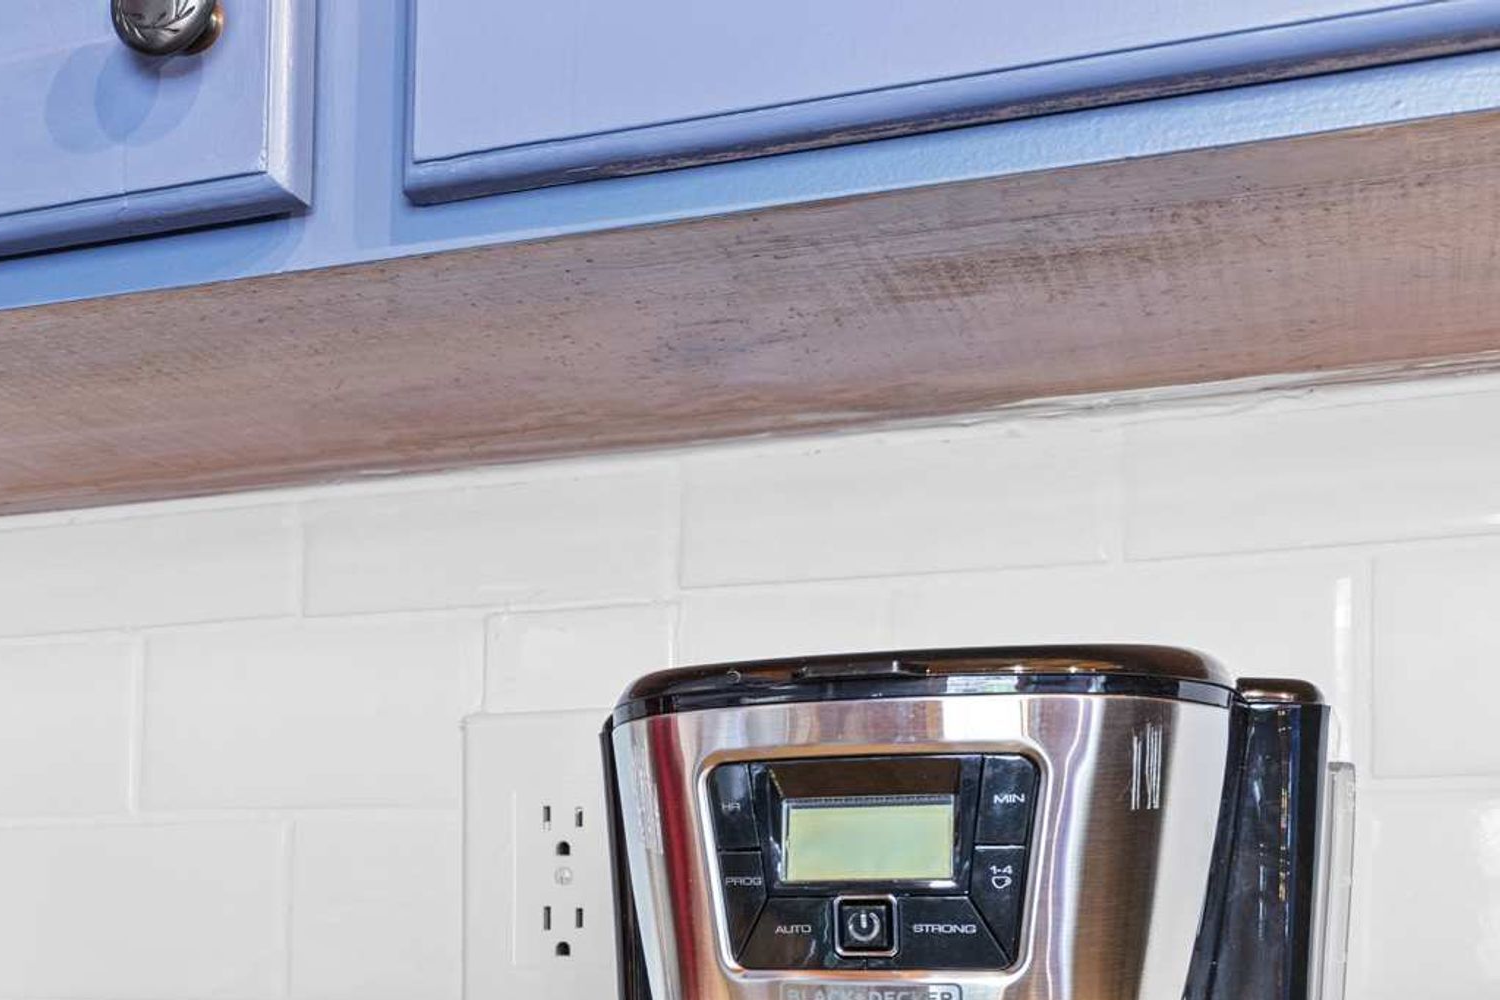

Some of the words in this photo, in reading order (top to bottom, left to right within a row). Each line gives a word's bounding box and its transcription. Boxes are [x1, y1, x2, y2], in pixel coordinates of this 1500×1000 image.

[993, 793, 1025, 804] MIN
[721, 802, 741, 812] HR
[989, 865, 1013, 876] 1-4
[725, 876, 762, 887] PROG
[774, 924, 812, 934] AUTO
[913, 923, 977, 934] STRONG
